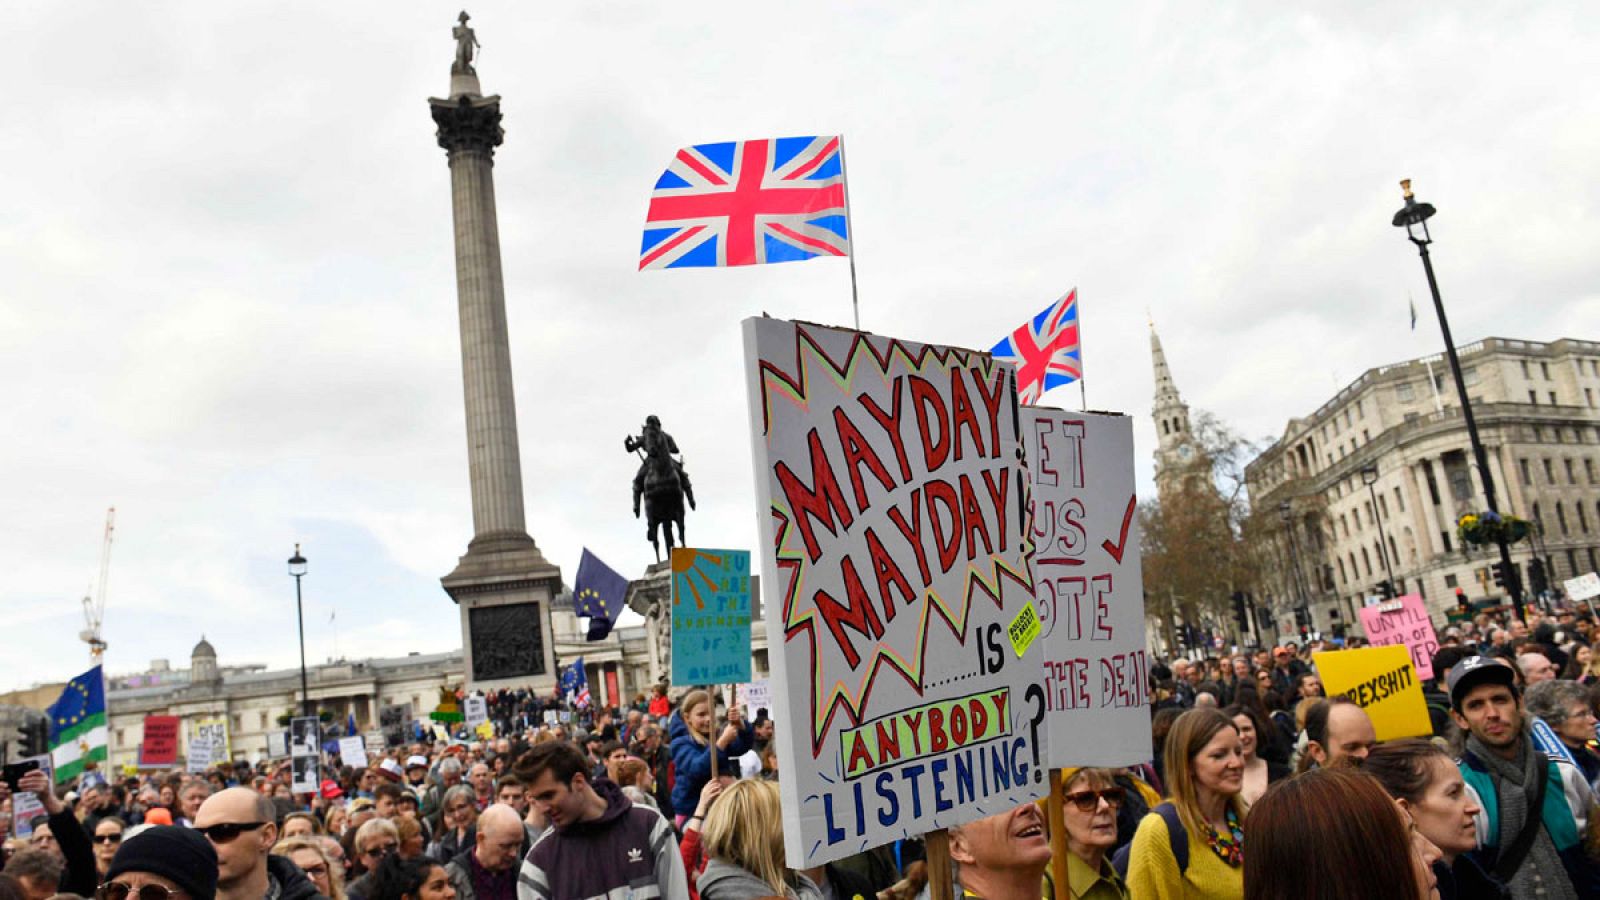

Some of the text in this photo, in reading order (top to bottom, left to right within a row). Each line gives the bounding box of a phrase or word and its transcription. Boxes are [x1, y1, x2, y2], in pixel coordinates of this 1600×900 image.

[774, 366, 1021, 565] MAYDAY!
[1035, 418, 1085, 488] ET
[1031, 497, 1087, 556] US
[813, 467, 1025, 671] MAYDAY!
[1037, 573, 1113, 641] OTE
[1367, 608, 1428, 634] UNTIL
[1412, 626, 1427, 641] OF
[1044, 650, 1152, 712] THE DEAL
[1337, 664, 1412, 708] REXSHIT
[824, 684, 1046, 846] LISTENING?
[847, 691, 1009, 773] ANYBODY
